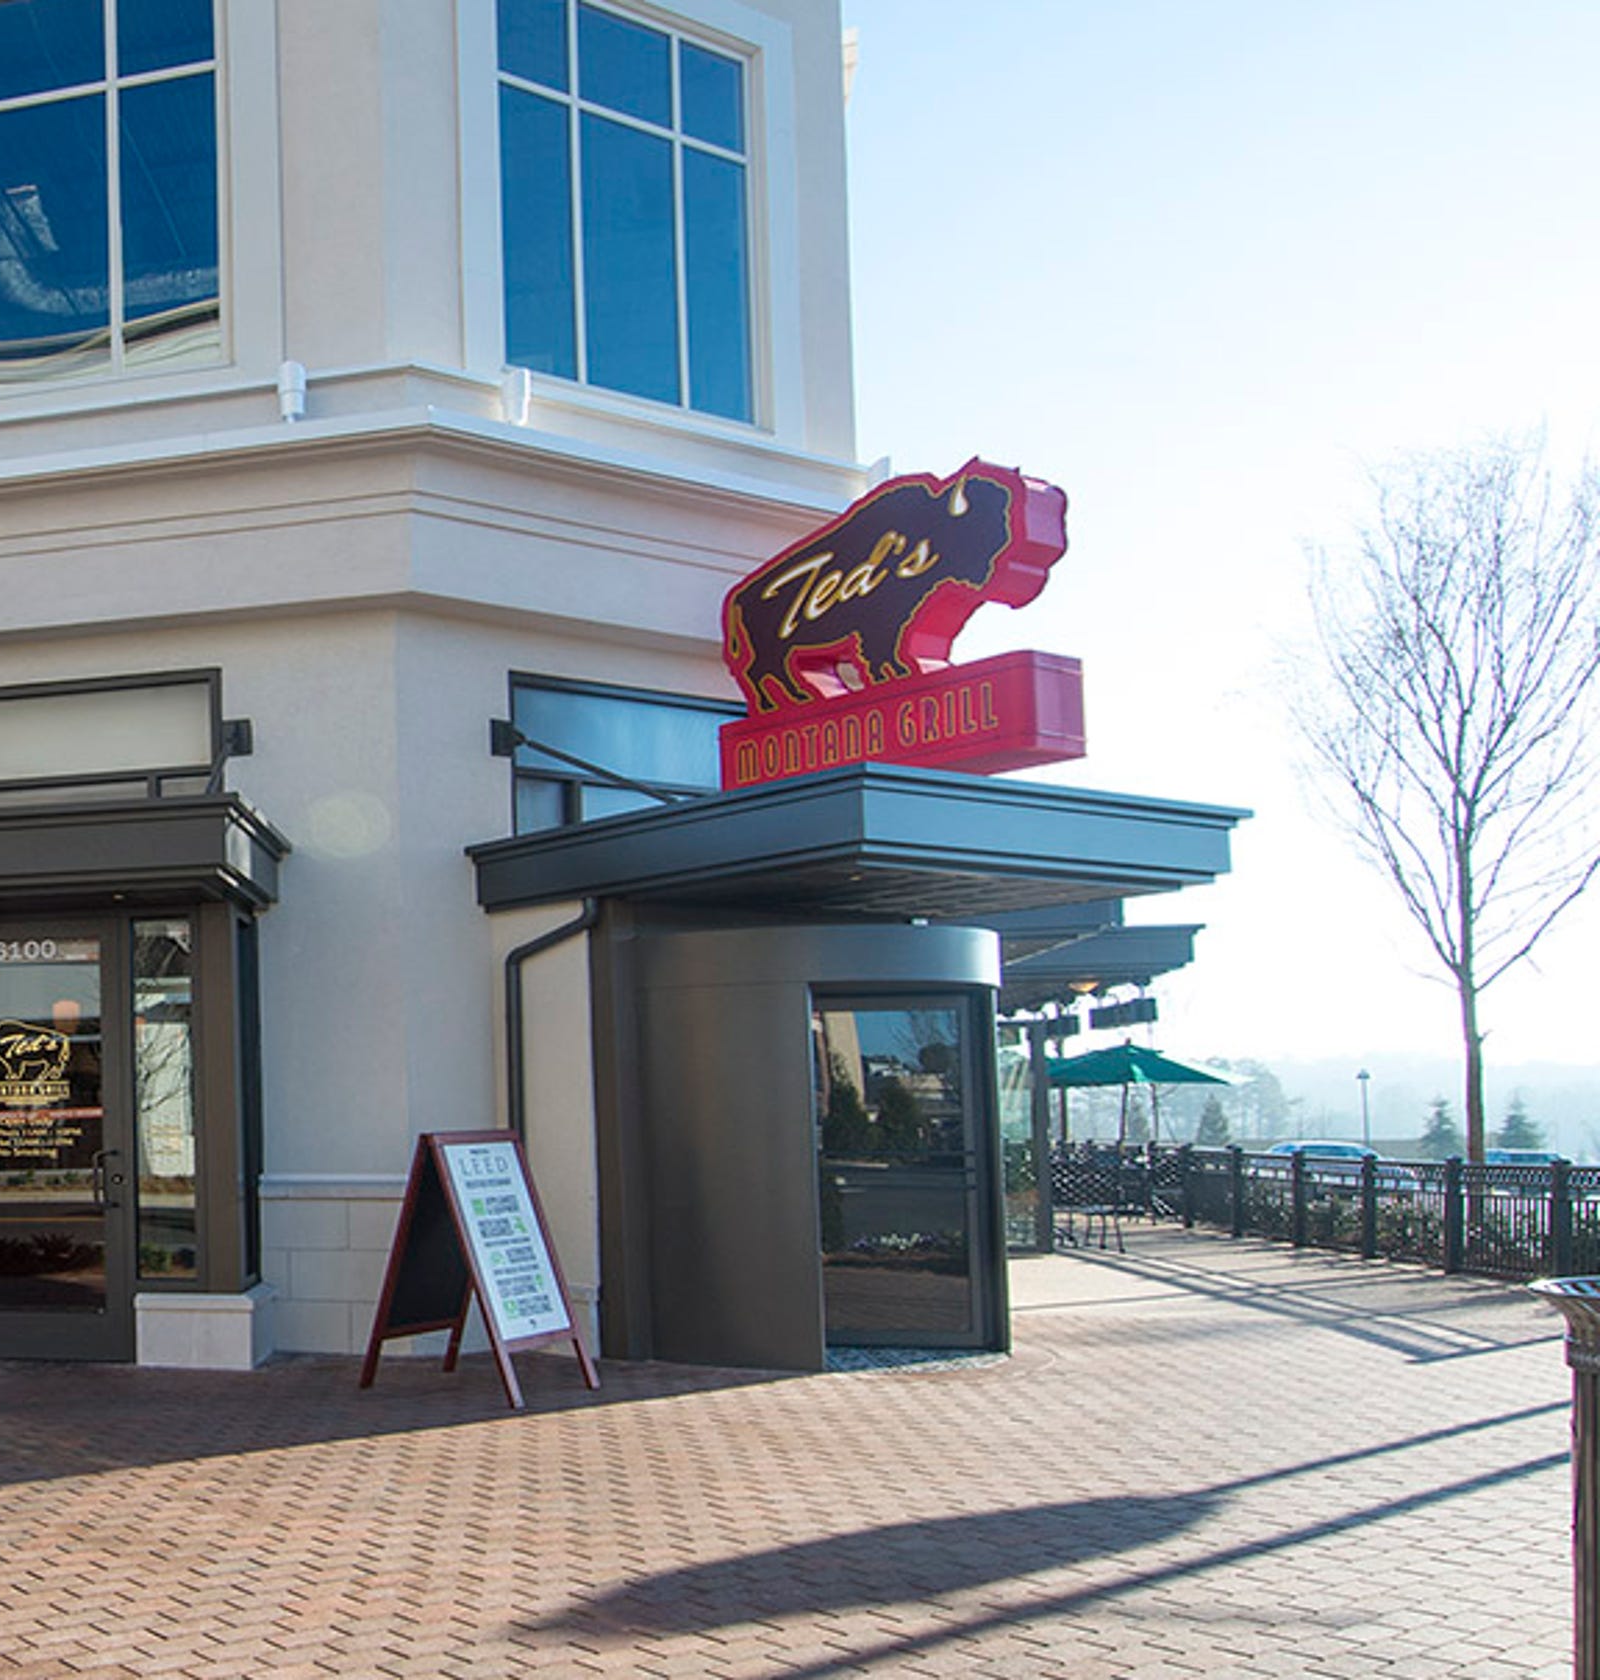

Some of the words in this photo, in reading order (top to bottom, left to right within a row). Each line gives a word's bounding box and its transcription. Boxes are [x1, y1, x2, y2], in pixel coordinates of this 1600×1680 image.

[761, 530, 941, 639] Ted's
[736, 709, 884, 784] MONTANA
[898, 682, 999, 748] GRILL
[0, 1034, 60, 1059] Ted's
[13, 1148, 59, 1160] Smoking
[458, 1156, 509, 1177] LEED
